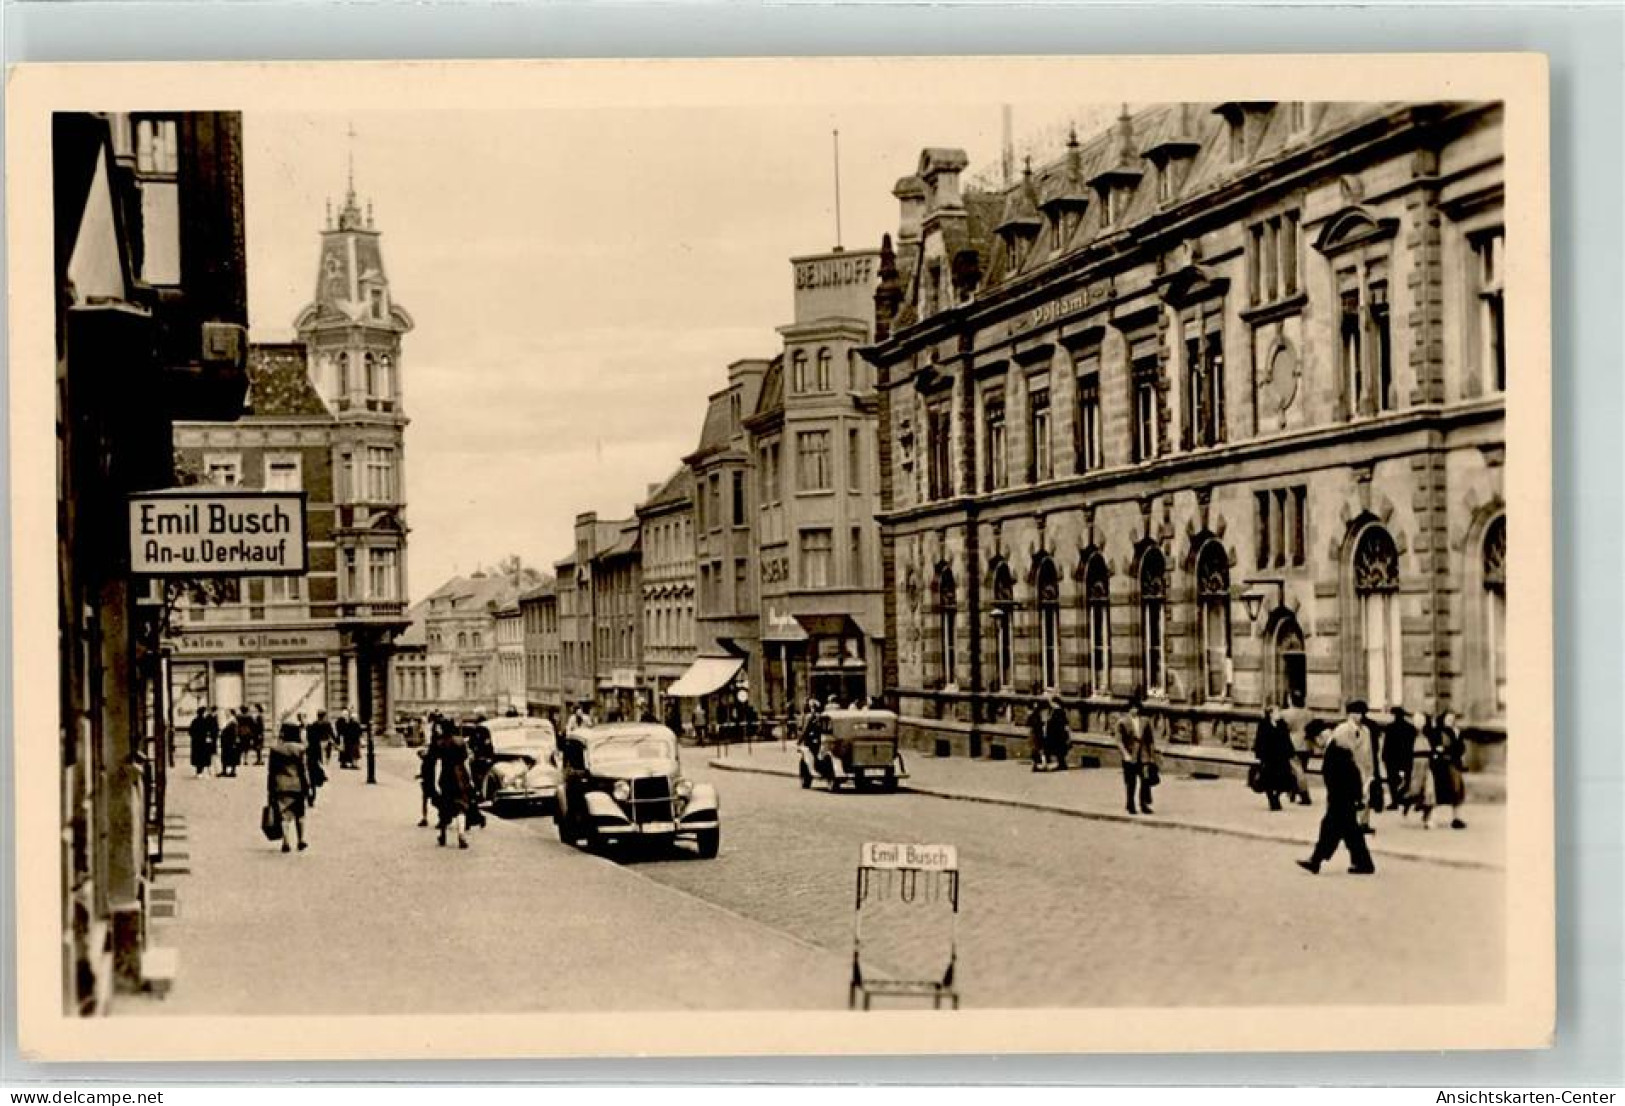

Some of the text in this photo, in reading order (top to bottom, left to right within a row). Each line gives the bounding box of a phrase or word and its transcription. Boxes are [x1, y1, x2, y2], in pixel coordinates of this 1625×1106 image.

[140, 503, 290, 535] Emil Busch
[182, 635, 224, 648] Salon
[871, 844, 948, 866] Emil Busch
